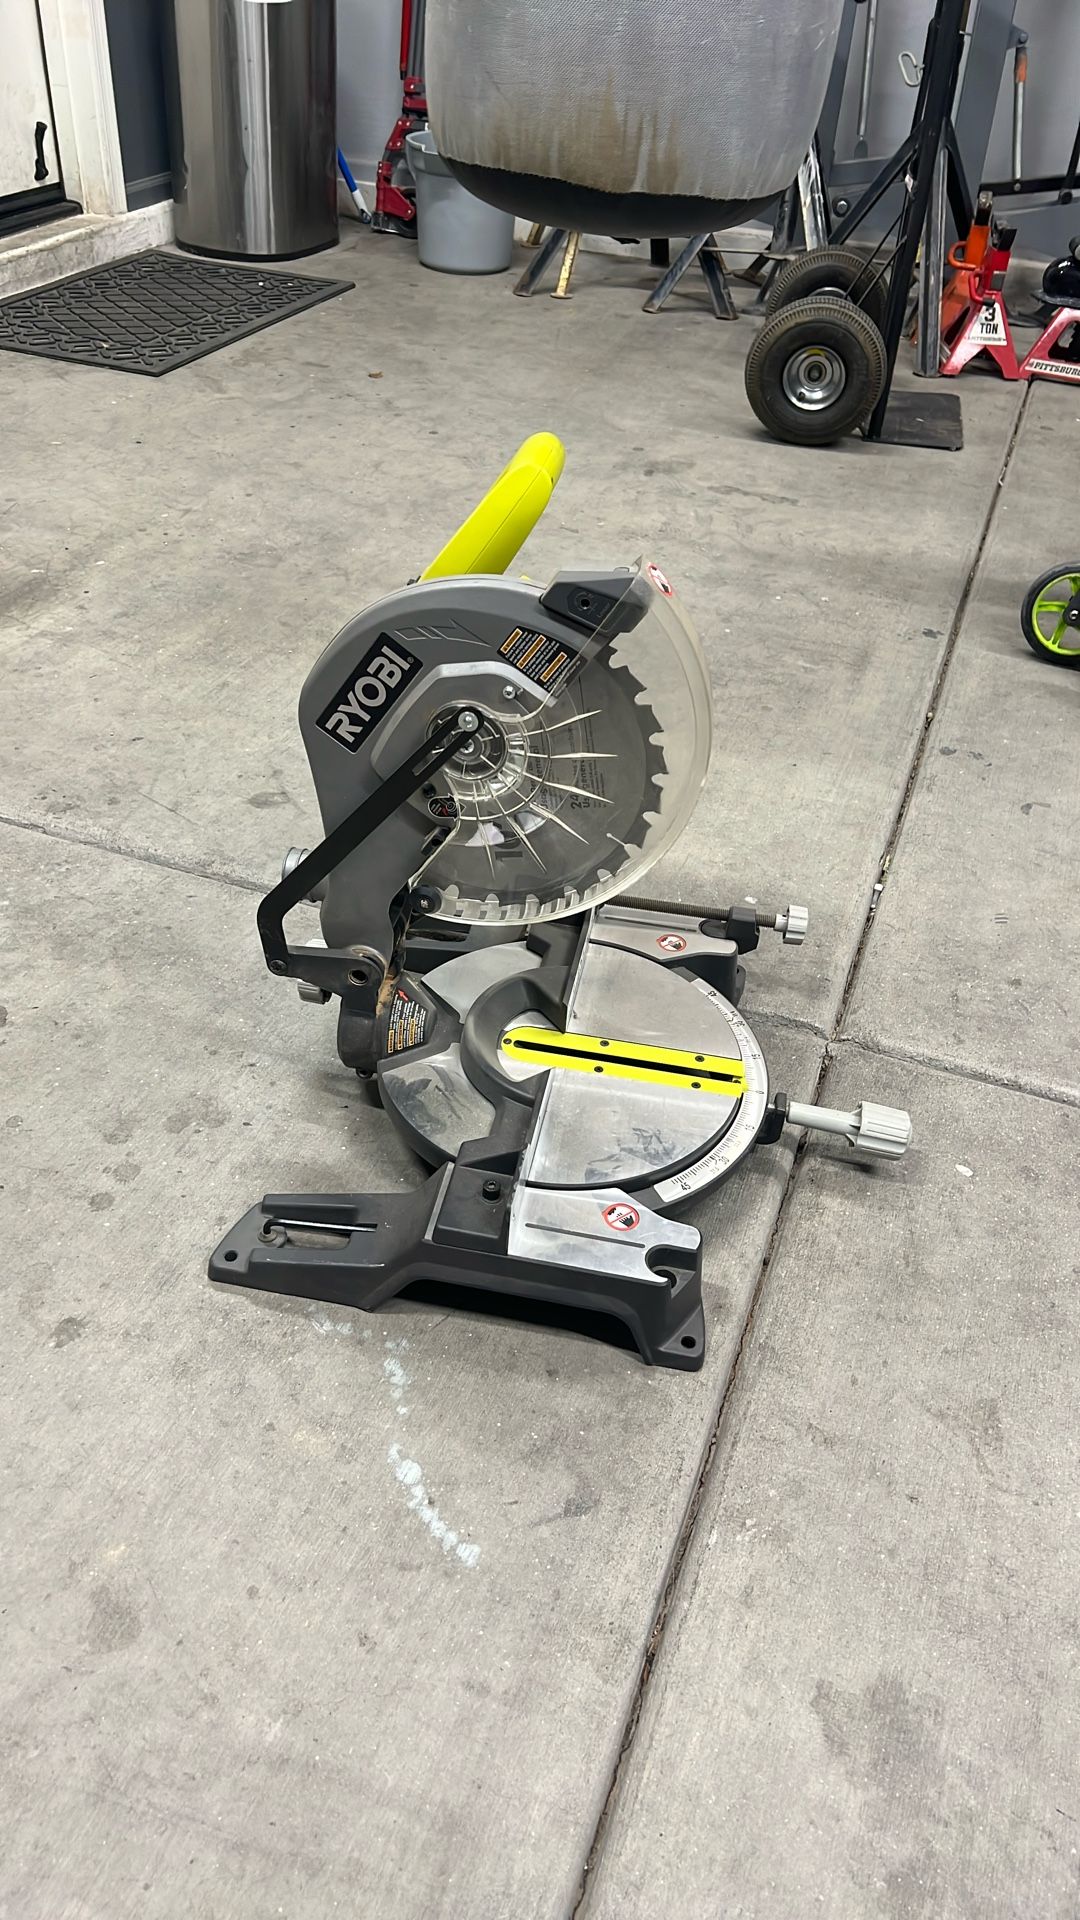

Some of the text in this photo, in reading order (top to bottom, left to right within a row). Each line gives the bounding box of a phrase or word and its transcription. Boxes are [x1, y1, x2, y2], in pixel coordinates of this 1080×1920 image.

[984, 306, 996, 322] 3
[980, 323, 999, 335] TON
[325, 645, 411, 743] RYOBI
[681, 1183, 691, 1191] 45
